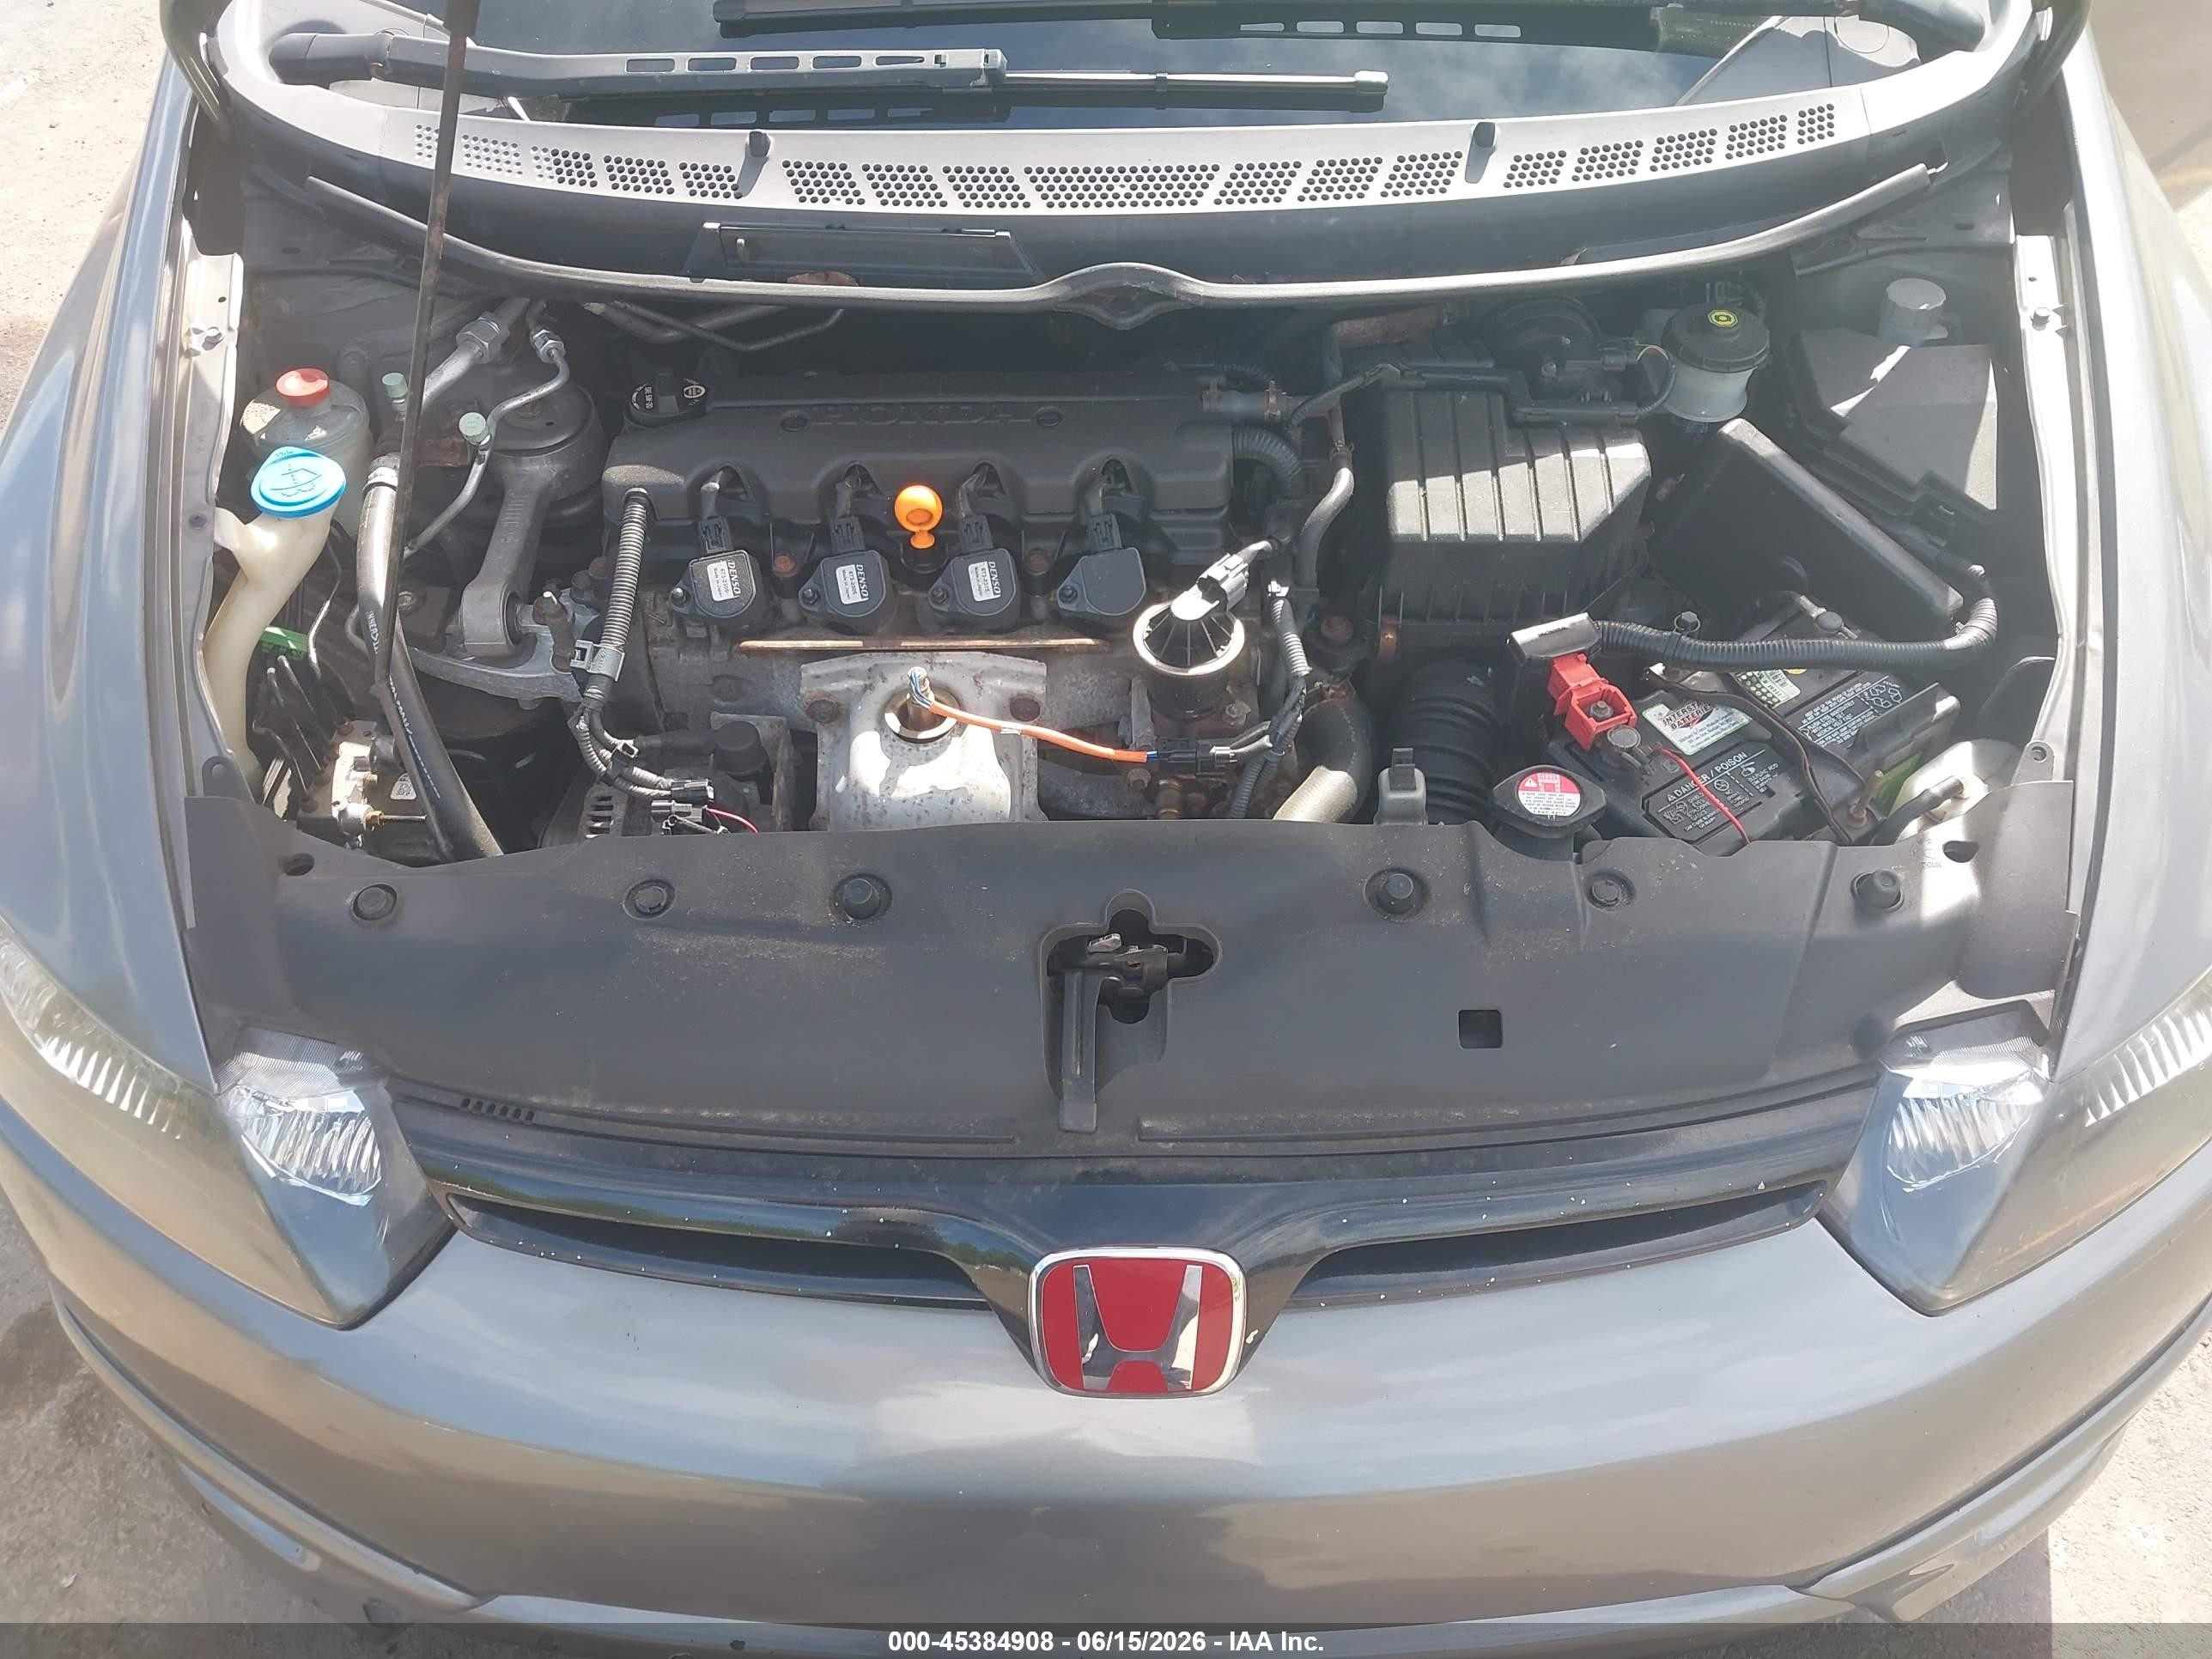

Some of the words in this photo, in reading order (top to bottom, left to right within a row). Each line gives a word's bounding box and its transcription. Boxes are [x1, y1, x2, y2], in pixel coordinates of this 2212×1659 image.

[727, 561, 741, 595] DENSO
[856, 563, 869, 598] DENSO
[988, 561, 1001, 594] DENSO
[1715, 750, 1747, 774] POISON
